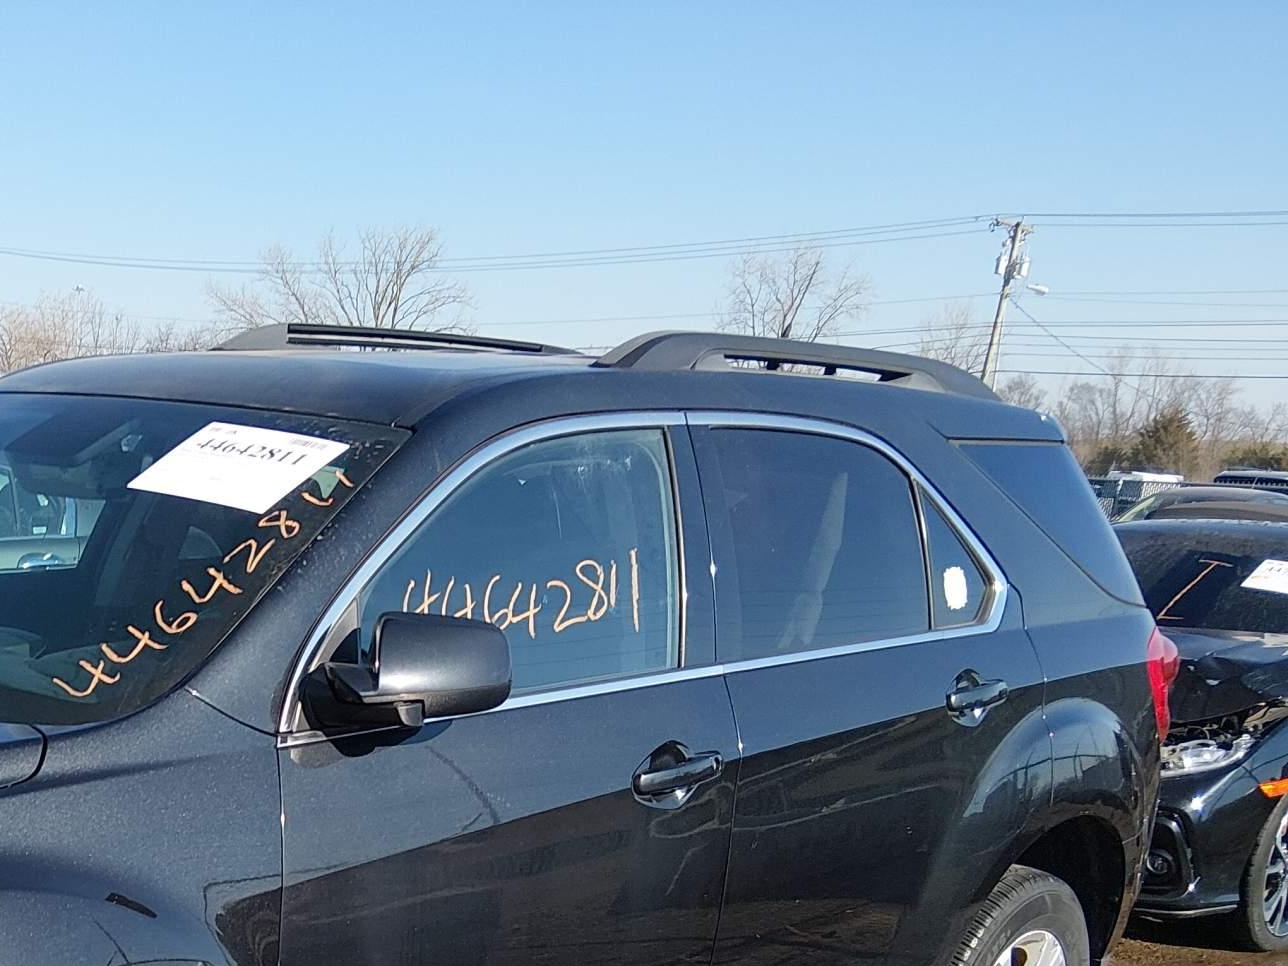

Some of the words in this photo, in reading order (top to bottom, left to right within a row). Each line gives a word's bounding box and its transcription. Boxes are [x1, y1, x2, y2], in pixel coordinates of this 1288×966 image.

[196, 438, 308, 466] 44642811
[52, 470, 355, 697] 44642811
[402, 547, 640, 640] 44642811
